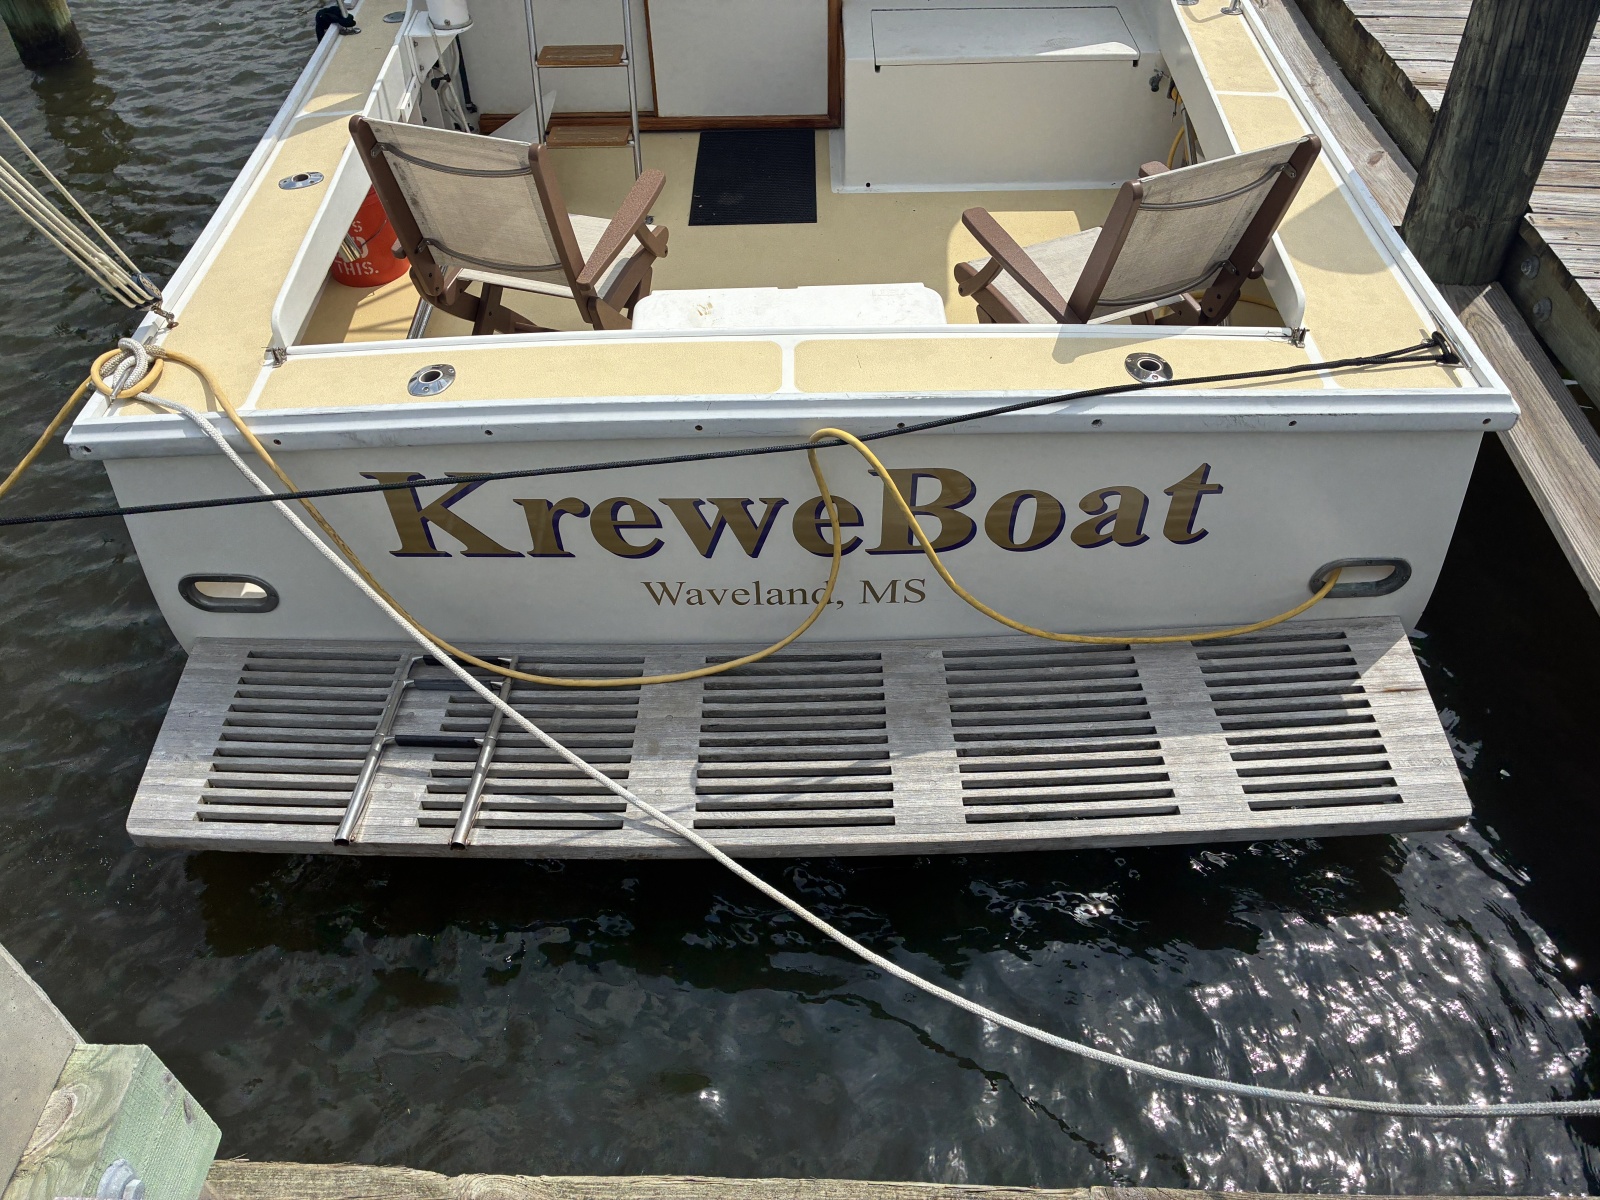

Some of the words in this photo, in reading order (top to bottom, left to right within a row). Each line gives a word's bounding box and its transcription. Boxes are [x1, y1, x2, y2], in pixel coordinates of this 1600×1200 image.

[334, 260, 379, 275] THIS.
[359, 462, 1224, 559] KreweBoat
[640, 579, 844, 610] Waveland,
[859, 578, 926, 604] MS
